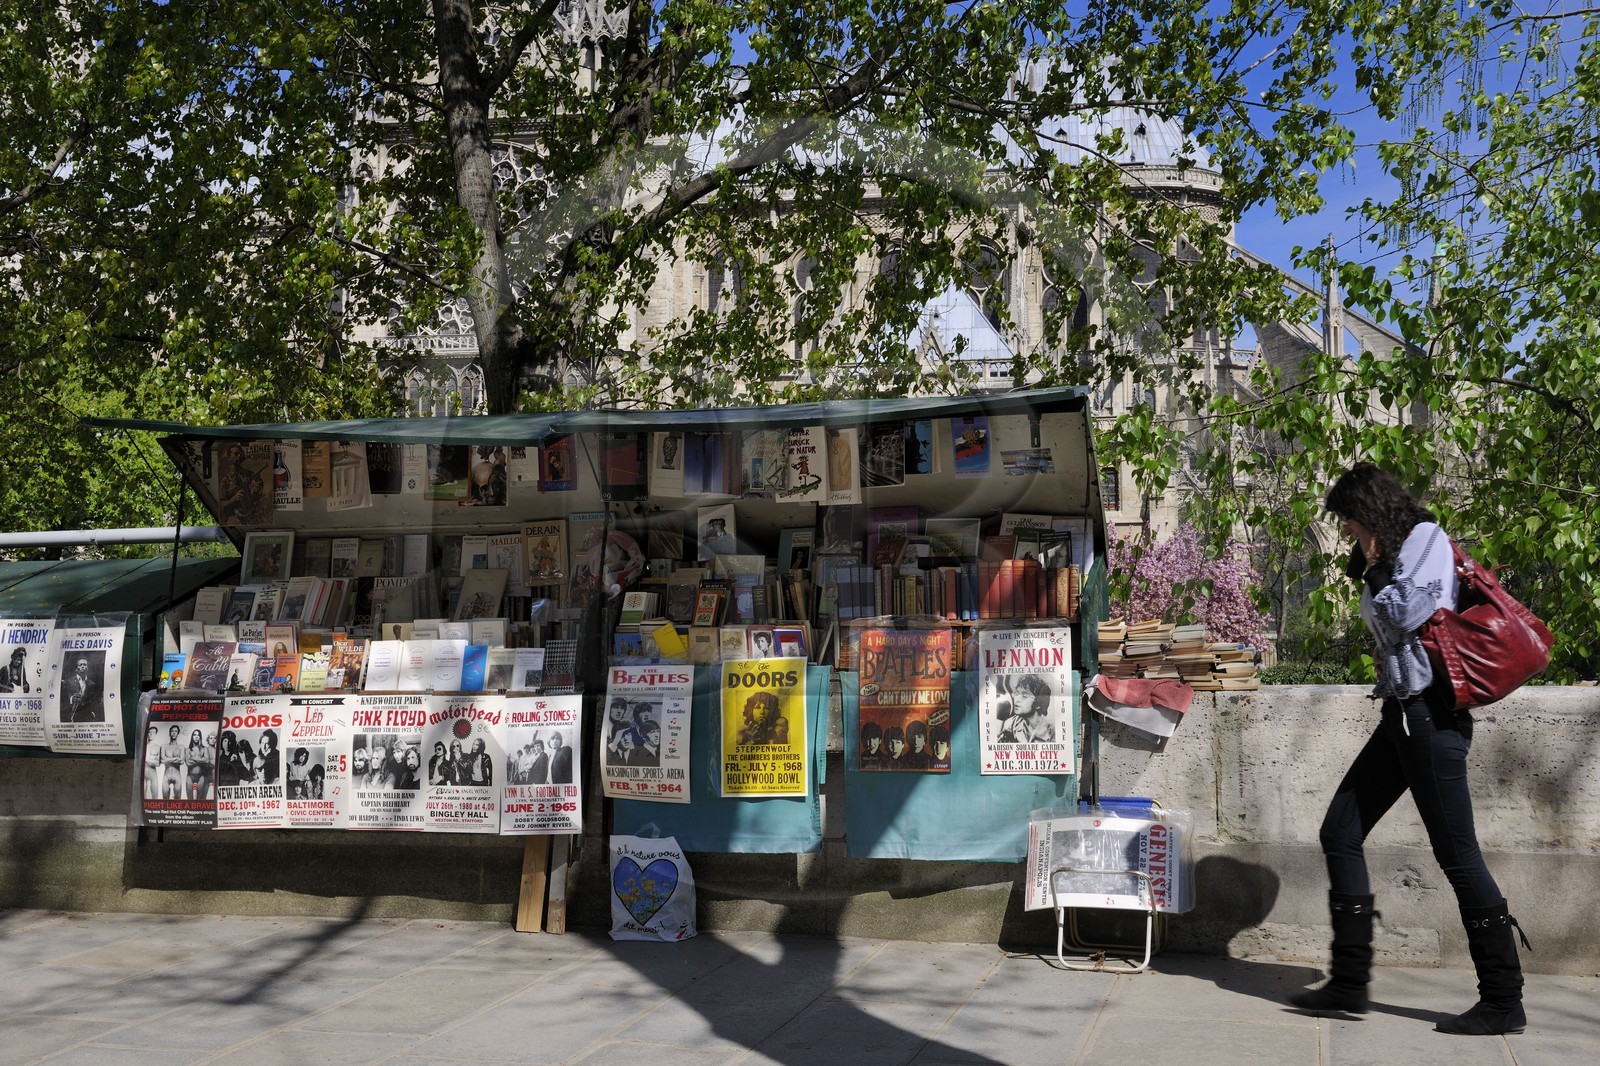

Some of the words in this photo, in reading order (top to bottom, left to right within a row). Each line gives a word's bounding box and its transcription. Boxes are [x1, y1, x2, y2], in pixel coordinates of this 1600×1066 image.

[796, 446, 816, 454] NATUR
[526, 525, 560, 536] DERAIN
[8, 629, 48, 644] HENDRIX
[876, 636, 895, 646] HARD
[87, 639, 113, 648] DAVIS
[1015, 640, 1034, 648] JOHN
[985, 648, 1064, 668] LENNON
[862, 646, 946, 683] BEATLES
[612, 670, 690, 685] BEATLES
[728, 671, 798, 688] DOORS
[360, 697, 402, 705] KNEBWORTH
[404, 696, 422, 704] PARK
[900, 691, 918, 704] BUY
[918, 690, 930, 704] ME
[430, 703, 502, 725] motörhead
[985, 702, 989, 714] TO
[222, 714, 283, 729] DOORS
[386, 710, 426, 726] FLOYD
[512, 711, 541, 723] ROLLING
[543, 710, 571, 722] STONES
[292, 720, 334, 737] ZEPPELIN
[994, 751, 1011, 760] NEW
[1015, 751, 1036, 759] YORK
[1040, 751, 1059, 759] CITY
[339, 755, 346, 772] 5
[725, 763, 741, 772] FRI.
[748, 763, 768, 771] JULY
[771, 762, 776, 771] 5
[783, 762, 802, 771] 1968
[994, 760, 1059, 770] AUG.30.1972
[606, 767, 640, 778] WASHINGTON
[642, 768, 664, 779] SPORTS
[667, 768, 685, 779] ARENA
[727, 773, 774, 784] HOLLYWOOD
[778, 773, 800, 784] BOWL
[218, 787, 233, 800] NEW
[234, 786, 258, 799] HAVEN
[260, 786, 283, 798] ARENA
[505, 787, 517, 798] LYNN
[536, 786, 561, 797] FOOTBALL
[564, 786, 577, 796] FIELD
[610, 781, 632, 790] FEB.
[657, 784, 682, 793] 1964
[219, 802, 238, 810] DEC.
[262, 800, 280, 809] 1967
[504, 804, 534, 813] JUNE
[538, 804, 545, 812] 2
[550, 802, 577, 812] 1965
[659, 851, 680, 859] vous
[1148, 824, 1167, 908] GENESIS
